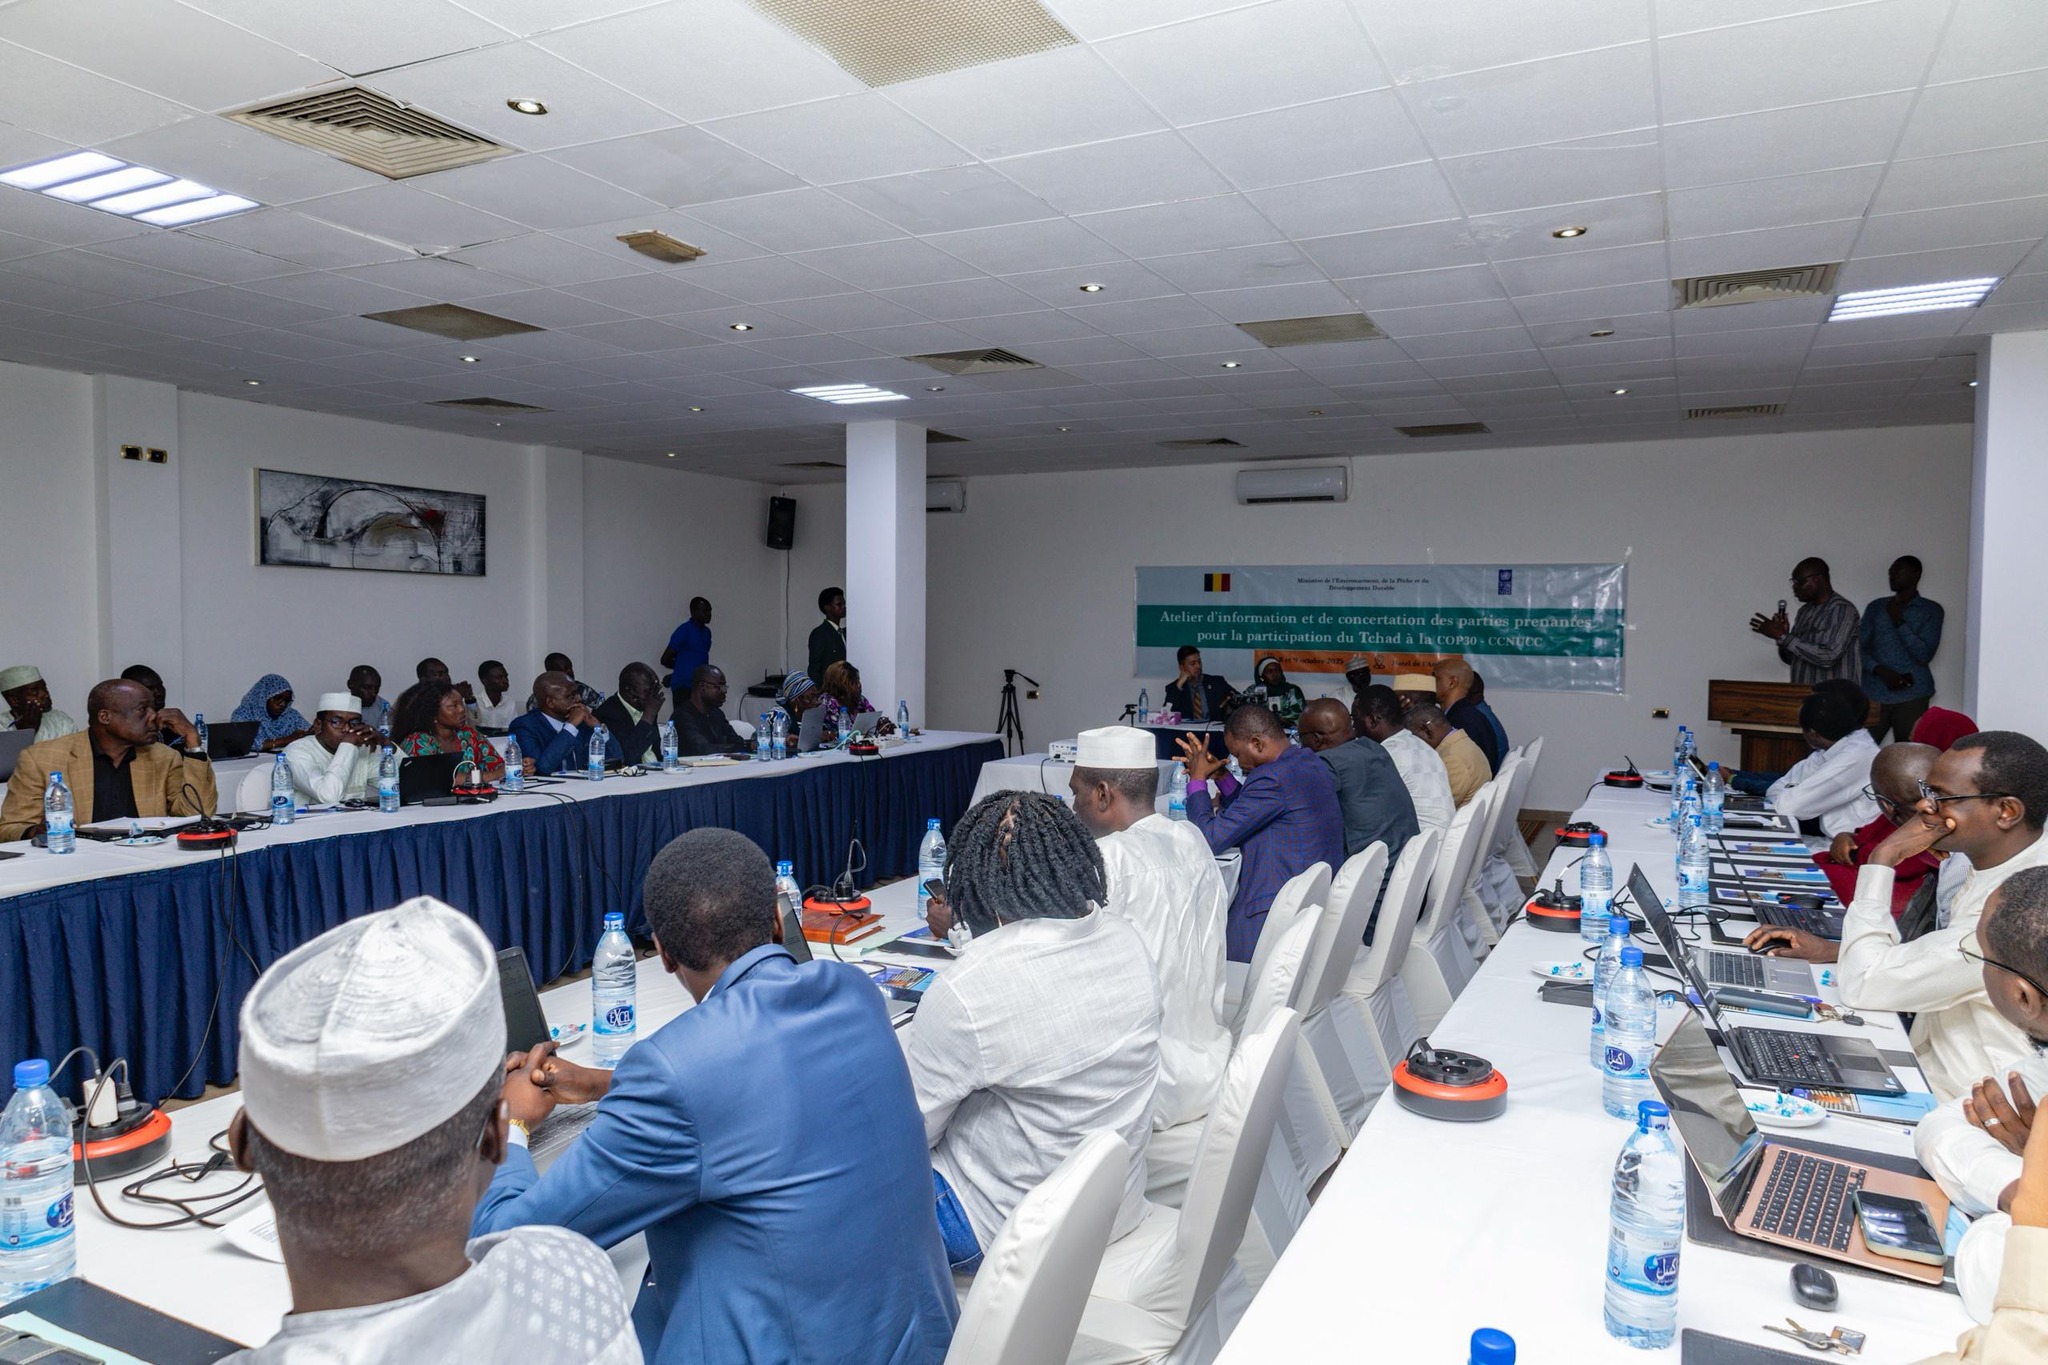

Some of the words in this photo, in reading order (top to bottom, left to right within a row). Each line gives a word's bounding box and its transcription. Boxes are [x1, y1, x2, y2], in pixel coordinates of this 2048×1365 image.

[1160, 611, 1203, 623] Atelier
[1207, 611, 1297, 624] d'information
[1301, 614, 1314, 624] et
[1318, 612, 1333, 624] de
[1338, 614, 1425, 626] concertation
[1430, 613, 1453, 627] des
[1458, 614, 1509, 629] parties
[1515, 616, 1592, 630] prenantes
[1197, 632, 1227, 643] pour
[1231, 629, 1242, 641] la
[1247, 631, 1332, 644] participation
[1336, 631, 1354, 643] du
[1359, 631, 1401, 644] Tchad
[1405, 633, 1413, 645] à
[1418, 632, 1432, 645] la
[1437, 635, 1477, 645] COP30
[1488, 636, 1543, 647] CCNUCC
[1326, 657, 1345, 665] 2025
